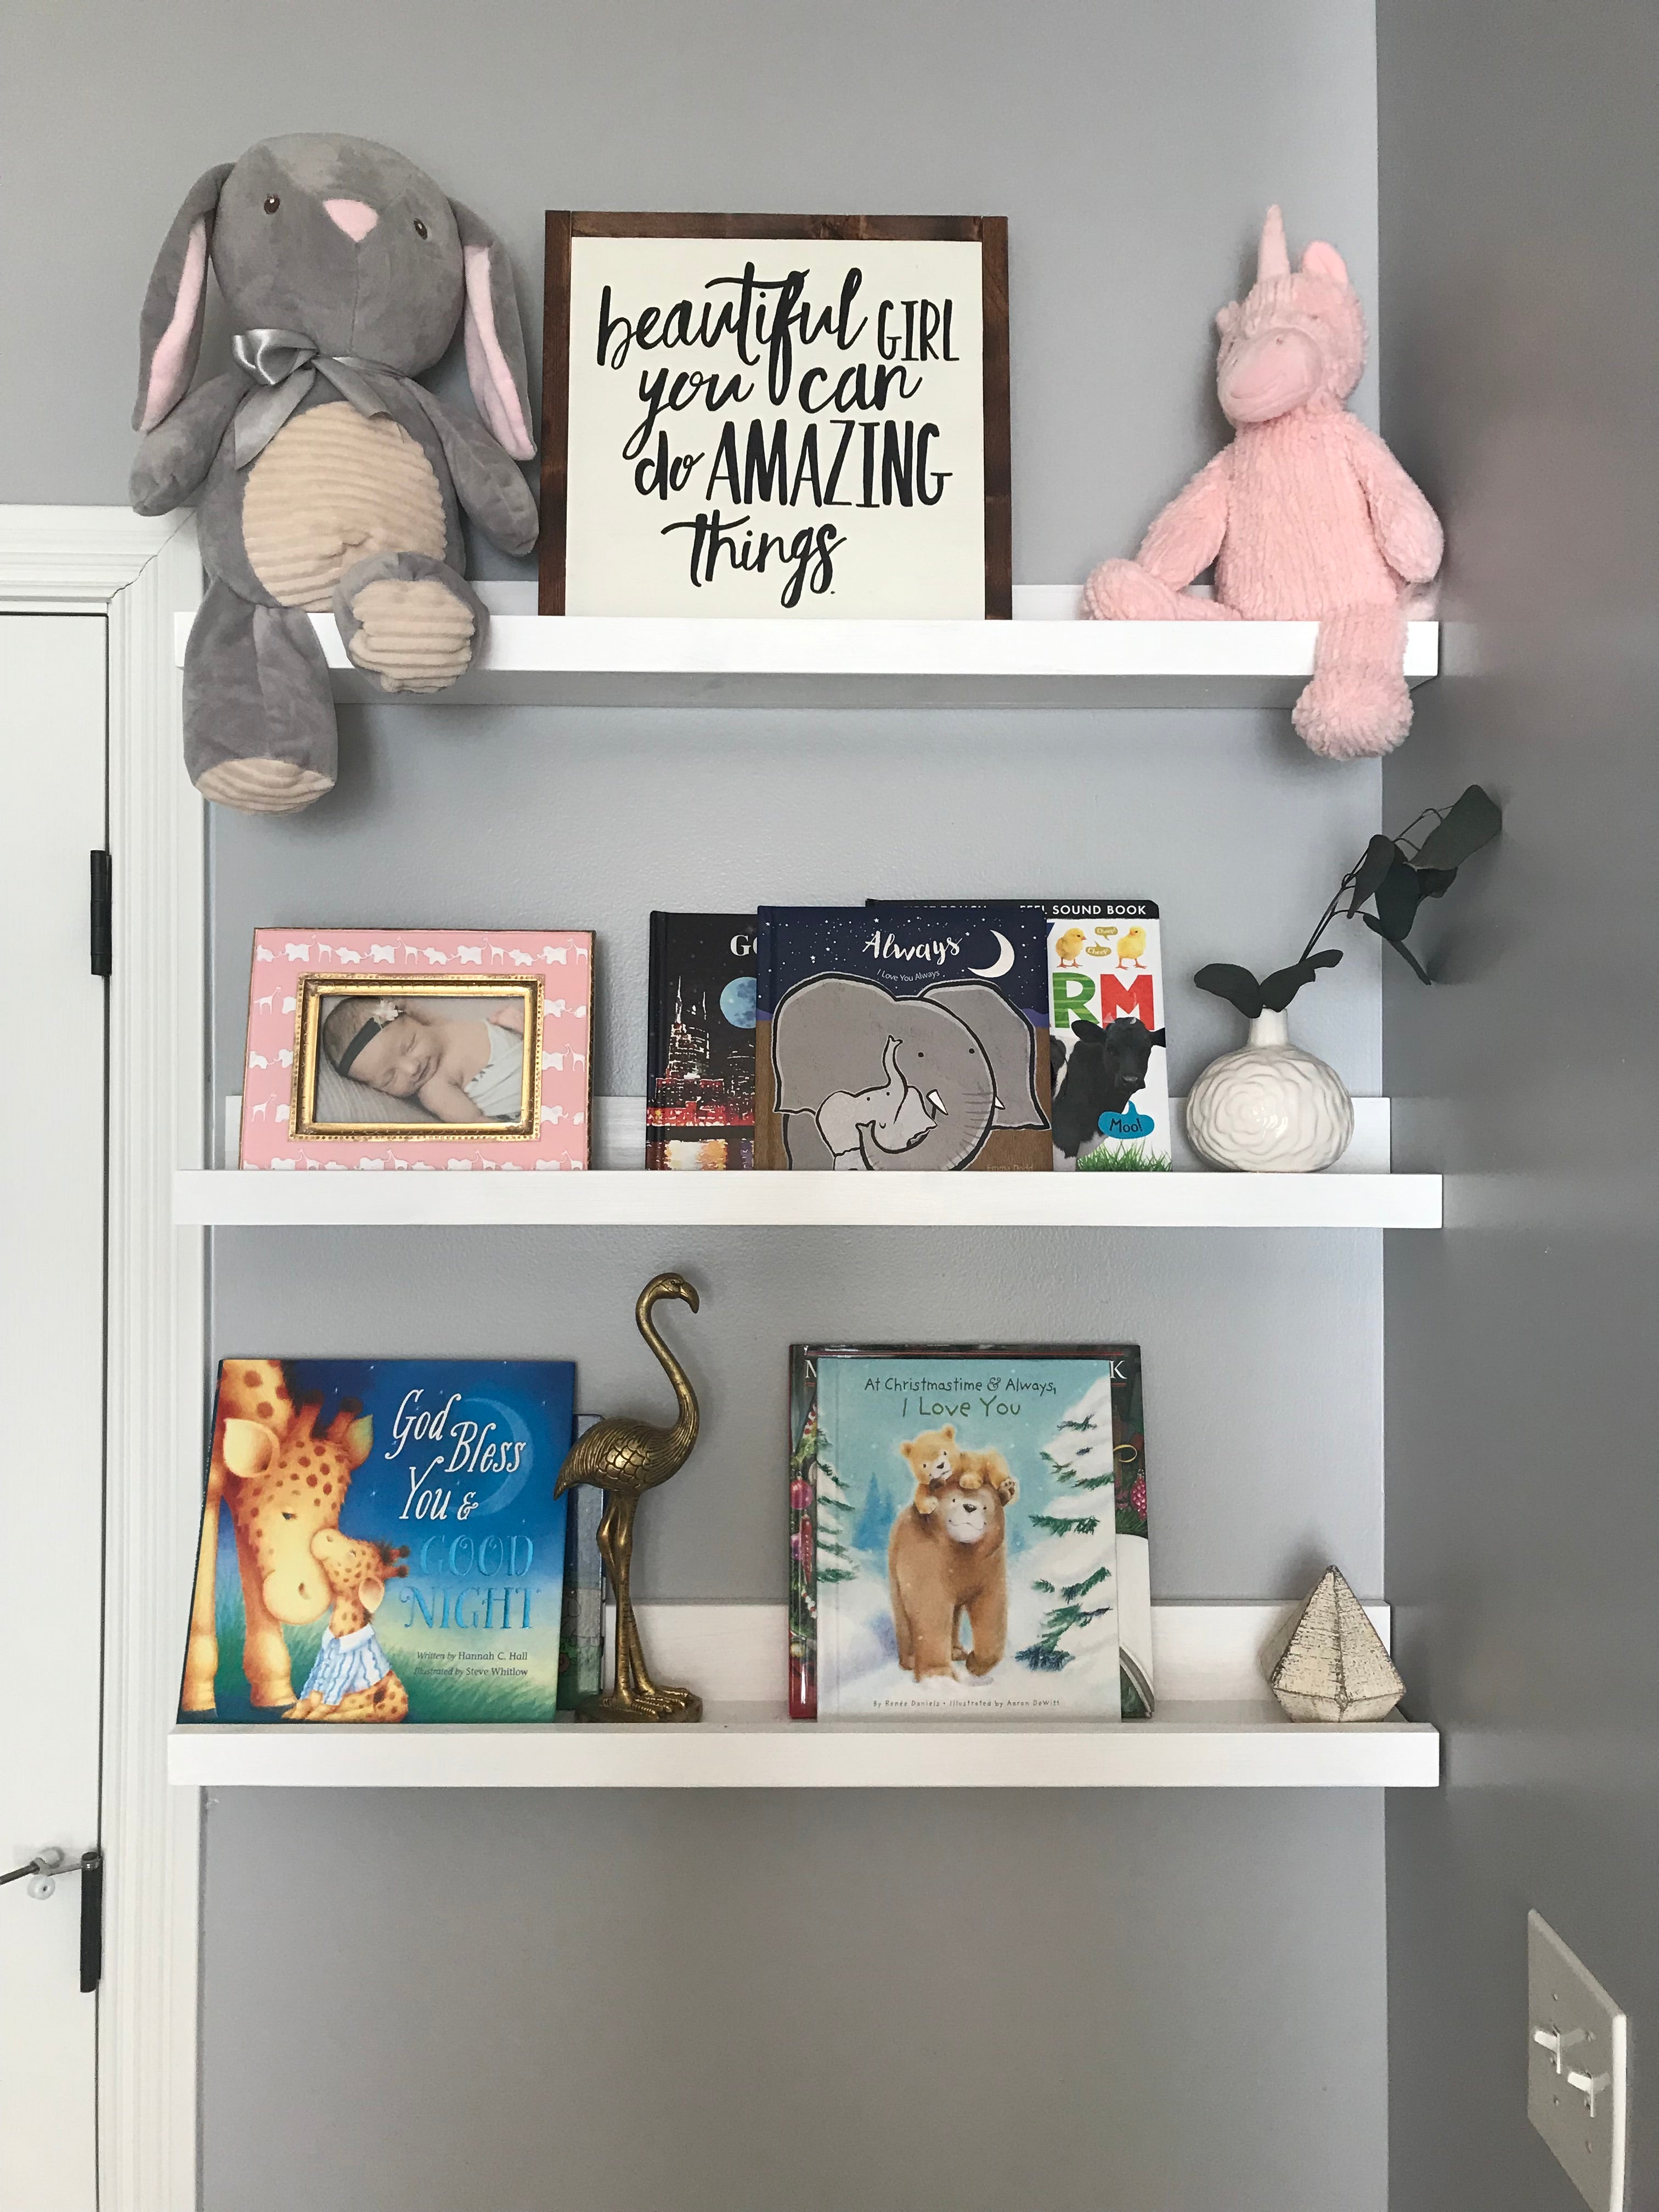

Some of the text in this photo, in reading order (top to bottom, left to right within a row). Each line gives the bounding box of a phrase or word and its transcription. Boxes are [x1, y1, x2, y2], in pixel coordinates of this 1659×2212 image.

[597, 262, 960, 405] beautiful GIRL
[622, 363, 923, 460] you can
[634, 418, 953, 508] do AMAZING
[1052, 905, 1101, 915] SOUND
[1107, 905, 1147, 915] BOOK
[862, 930, 962, 965] Always
[881, 970, 899, 981] Love
[915, 970, 940, 980] Always
[1052, 972, 1155, 1030] RM
[1109, 1118, 1143, 1133] Moo!
[864, 1377, 1057, 1397] At Christmastime & Always,
[902, 1395, 1021, 1418] I Love You
[385, 1389, 527, 1473] God Bless
[398, 1455, 479, 1521] You &
[420, 1534, 534, 1576] GOOD
[400, 1585, 541, 1629] NIGHT
[414, 1667, 528, 1677] Illustrated by Steve Whitlow
[417, 1651, 445, 1660] Written
[447, 1651, 456, 1661] by
[458, 1651, 494, 1661] Hannah
[509, 1651, 528, 1660] Hall
[873, 1700, 882, 1708] By
[995, 1700, 1003, 1708] by
